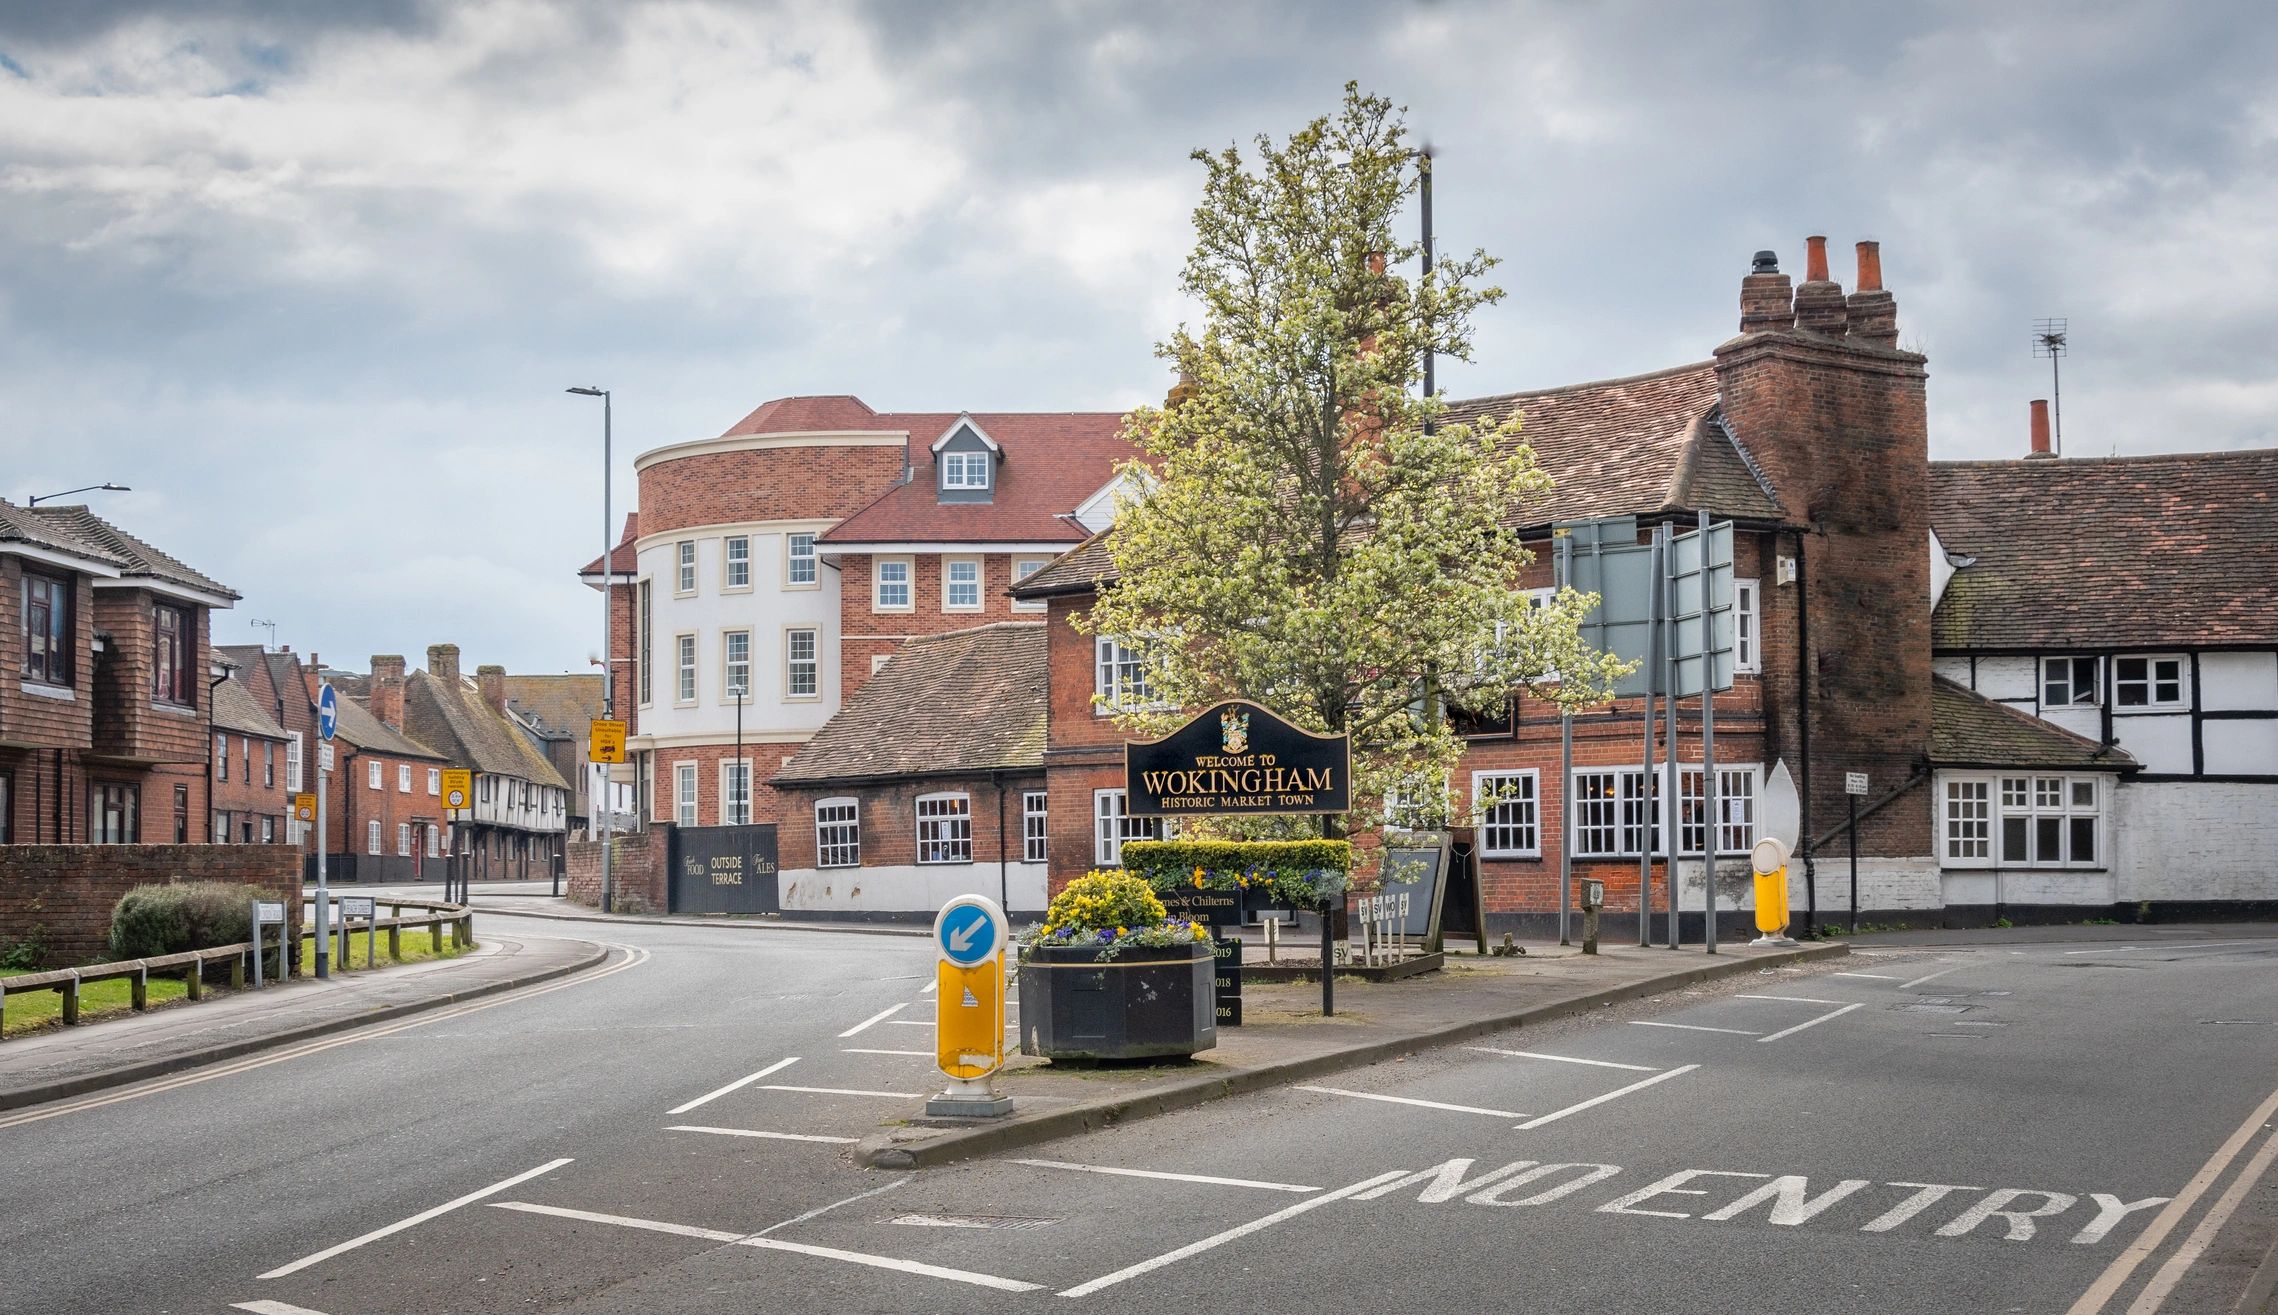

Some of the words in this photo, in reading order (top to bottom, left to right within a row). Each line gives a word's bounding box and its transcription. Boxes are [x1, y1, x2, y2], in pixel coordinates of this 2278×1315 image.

[1195, 756, 1254, 768] WELCOME
[1259, 754, 1276, 766] TO
[1142, 767, 1334, 795] WOKINGHAM
[1161, 796, 1215, 809] HISTORIC
[1220, 795, 1272, 807] MARKET
[1279, 794, 1314, 806] TOWN
[711, 856, 742, 869] OUTSIDE
[756, 862, 775, 874] ALES
[687, 864, 704, 875] FOOD
[711, 872, 742, 885] TERRACE
[1181, 896, 1190, 907] &
[1191, 895, 1235, 907] Chilterns
[1179, 911, 1210, 922] Bloom
[1333, 947, 1349, 958] SV
[1215, 977, 1231, 988] 018
[1216, 1006, 1232, 1017] 016
[1347, 1157, 1625, 1207] NO
[1594, 1168, 2174, 1244] ENTRY
